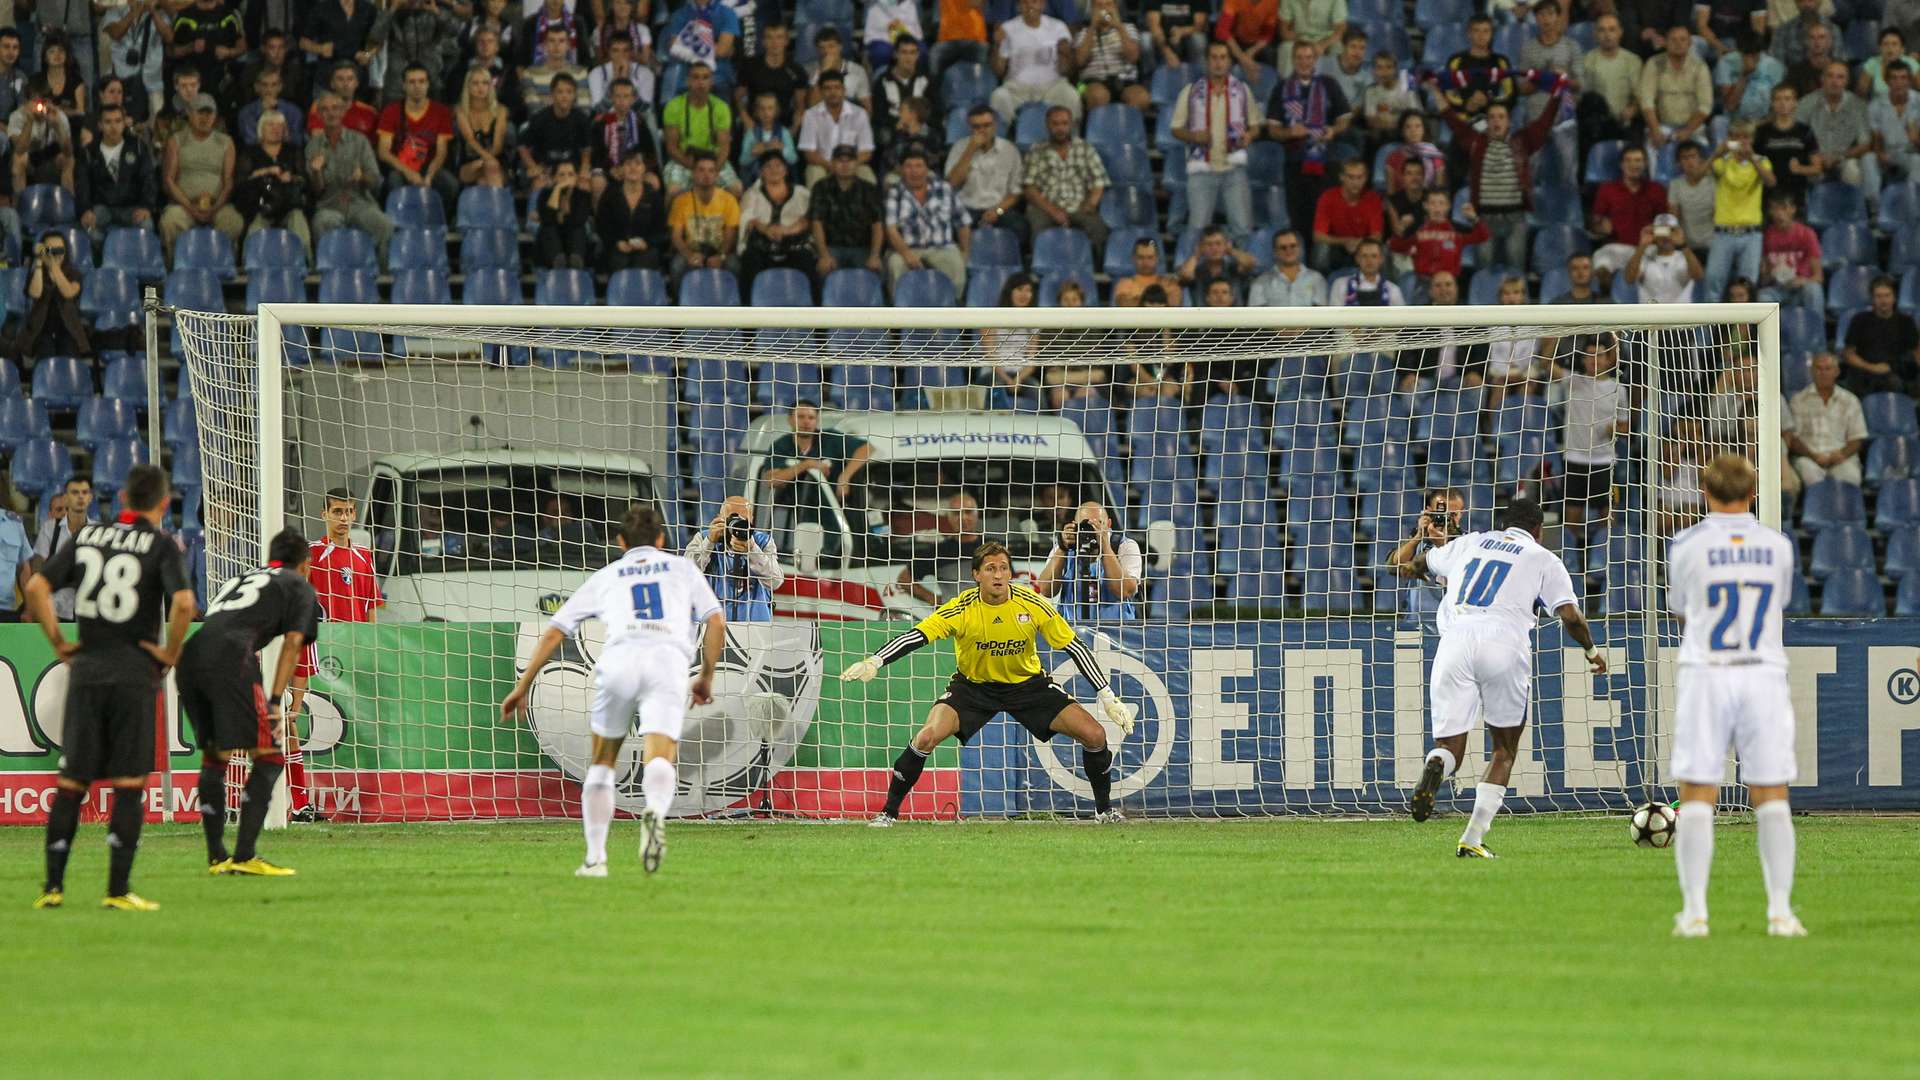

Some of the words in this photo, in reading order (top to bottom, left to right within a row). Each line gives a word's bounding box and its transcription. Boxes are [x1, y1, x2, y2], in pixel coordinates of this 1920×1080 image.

[75, 525, 155, 554] KAPLAN
[1480, 539, 1524, 555] IDAHOR
[75, 545, 141, 623] 28
[617, 560, 671, 577] KOVPAK
[1455, 557, 1513, 607] 10
[631, 582, 664, 620] 9
[1707, 581, 1774, 651] 27
